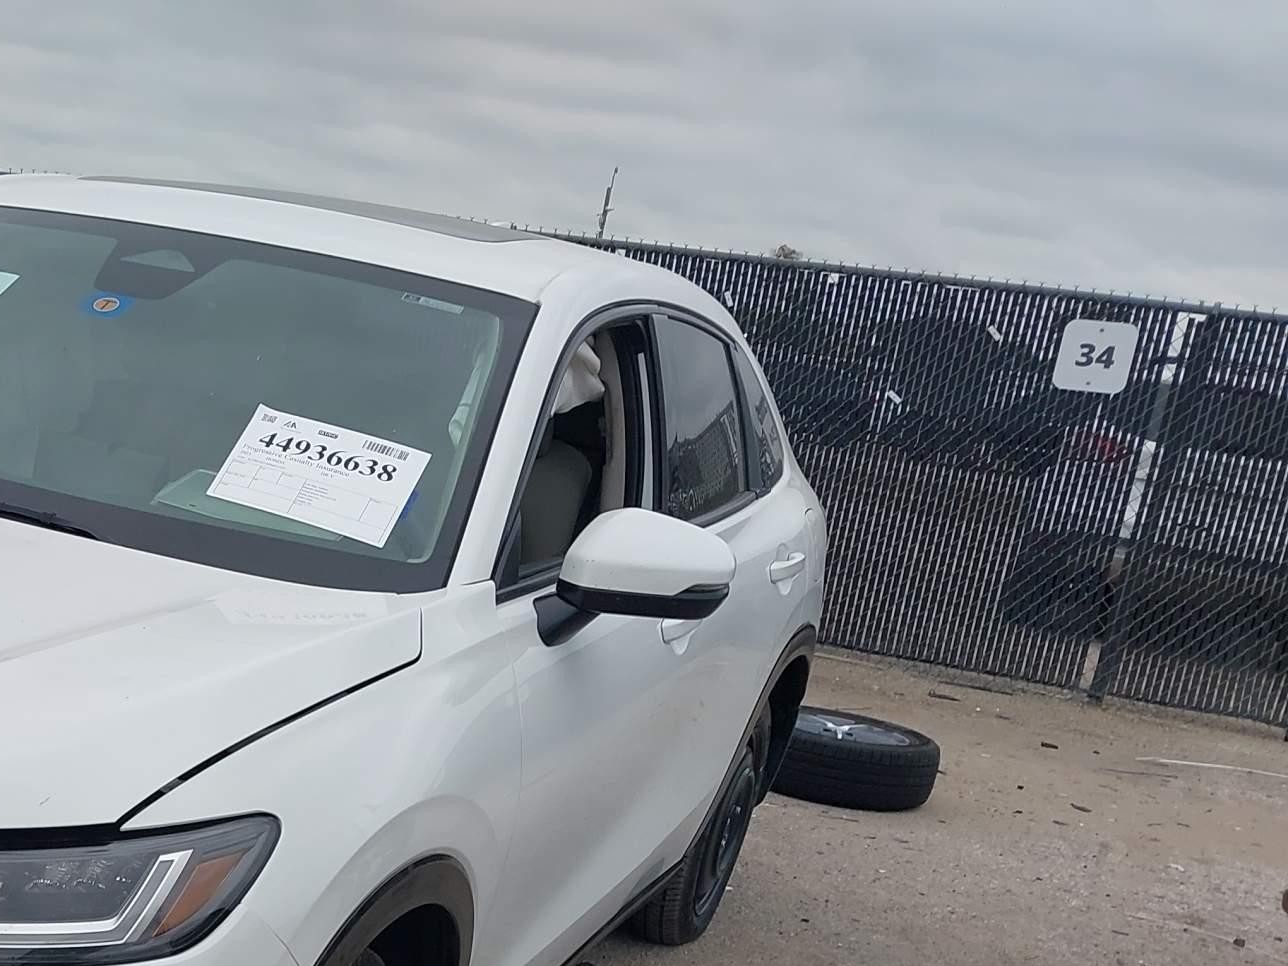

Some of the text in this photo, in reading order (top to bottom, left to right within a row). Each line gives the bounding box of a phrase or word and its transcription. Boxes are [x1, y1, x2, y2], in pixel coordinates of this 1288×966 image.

[1074, 343, 1116, 369] 34
[258, 431, 398, 483] 44936638
[315, 463, 351, 477] Insurance
